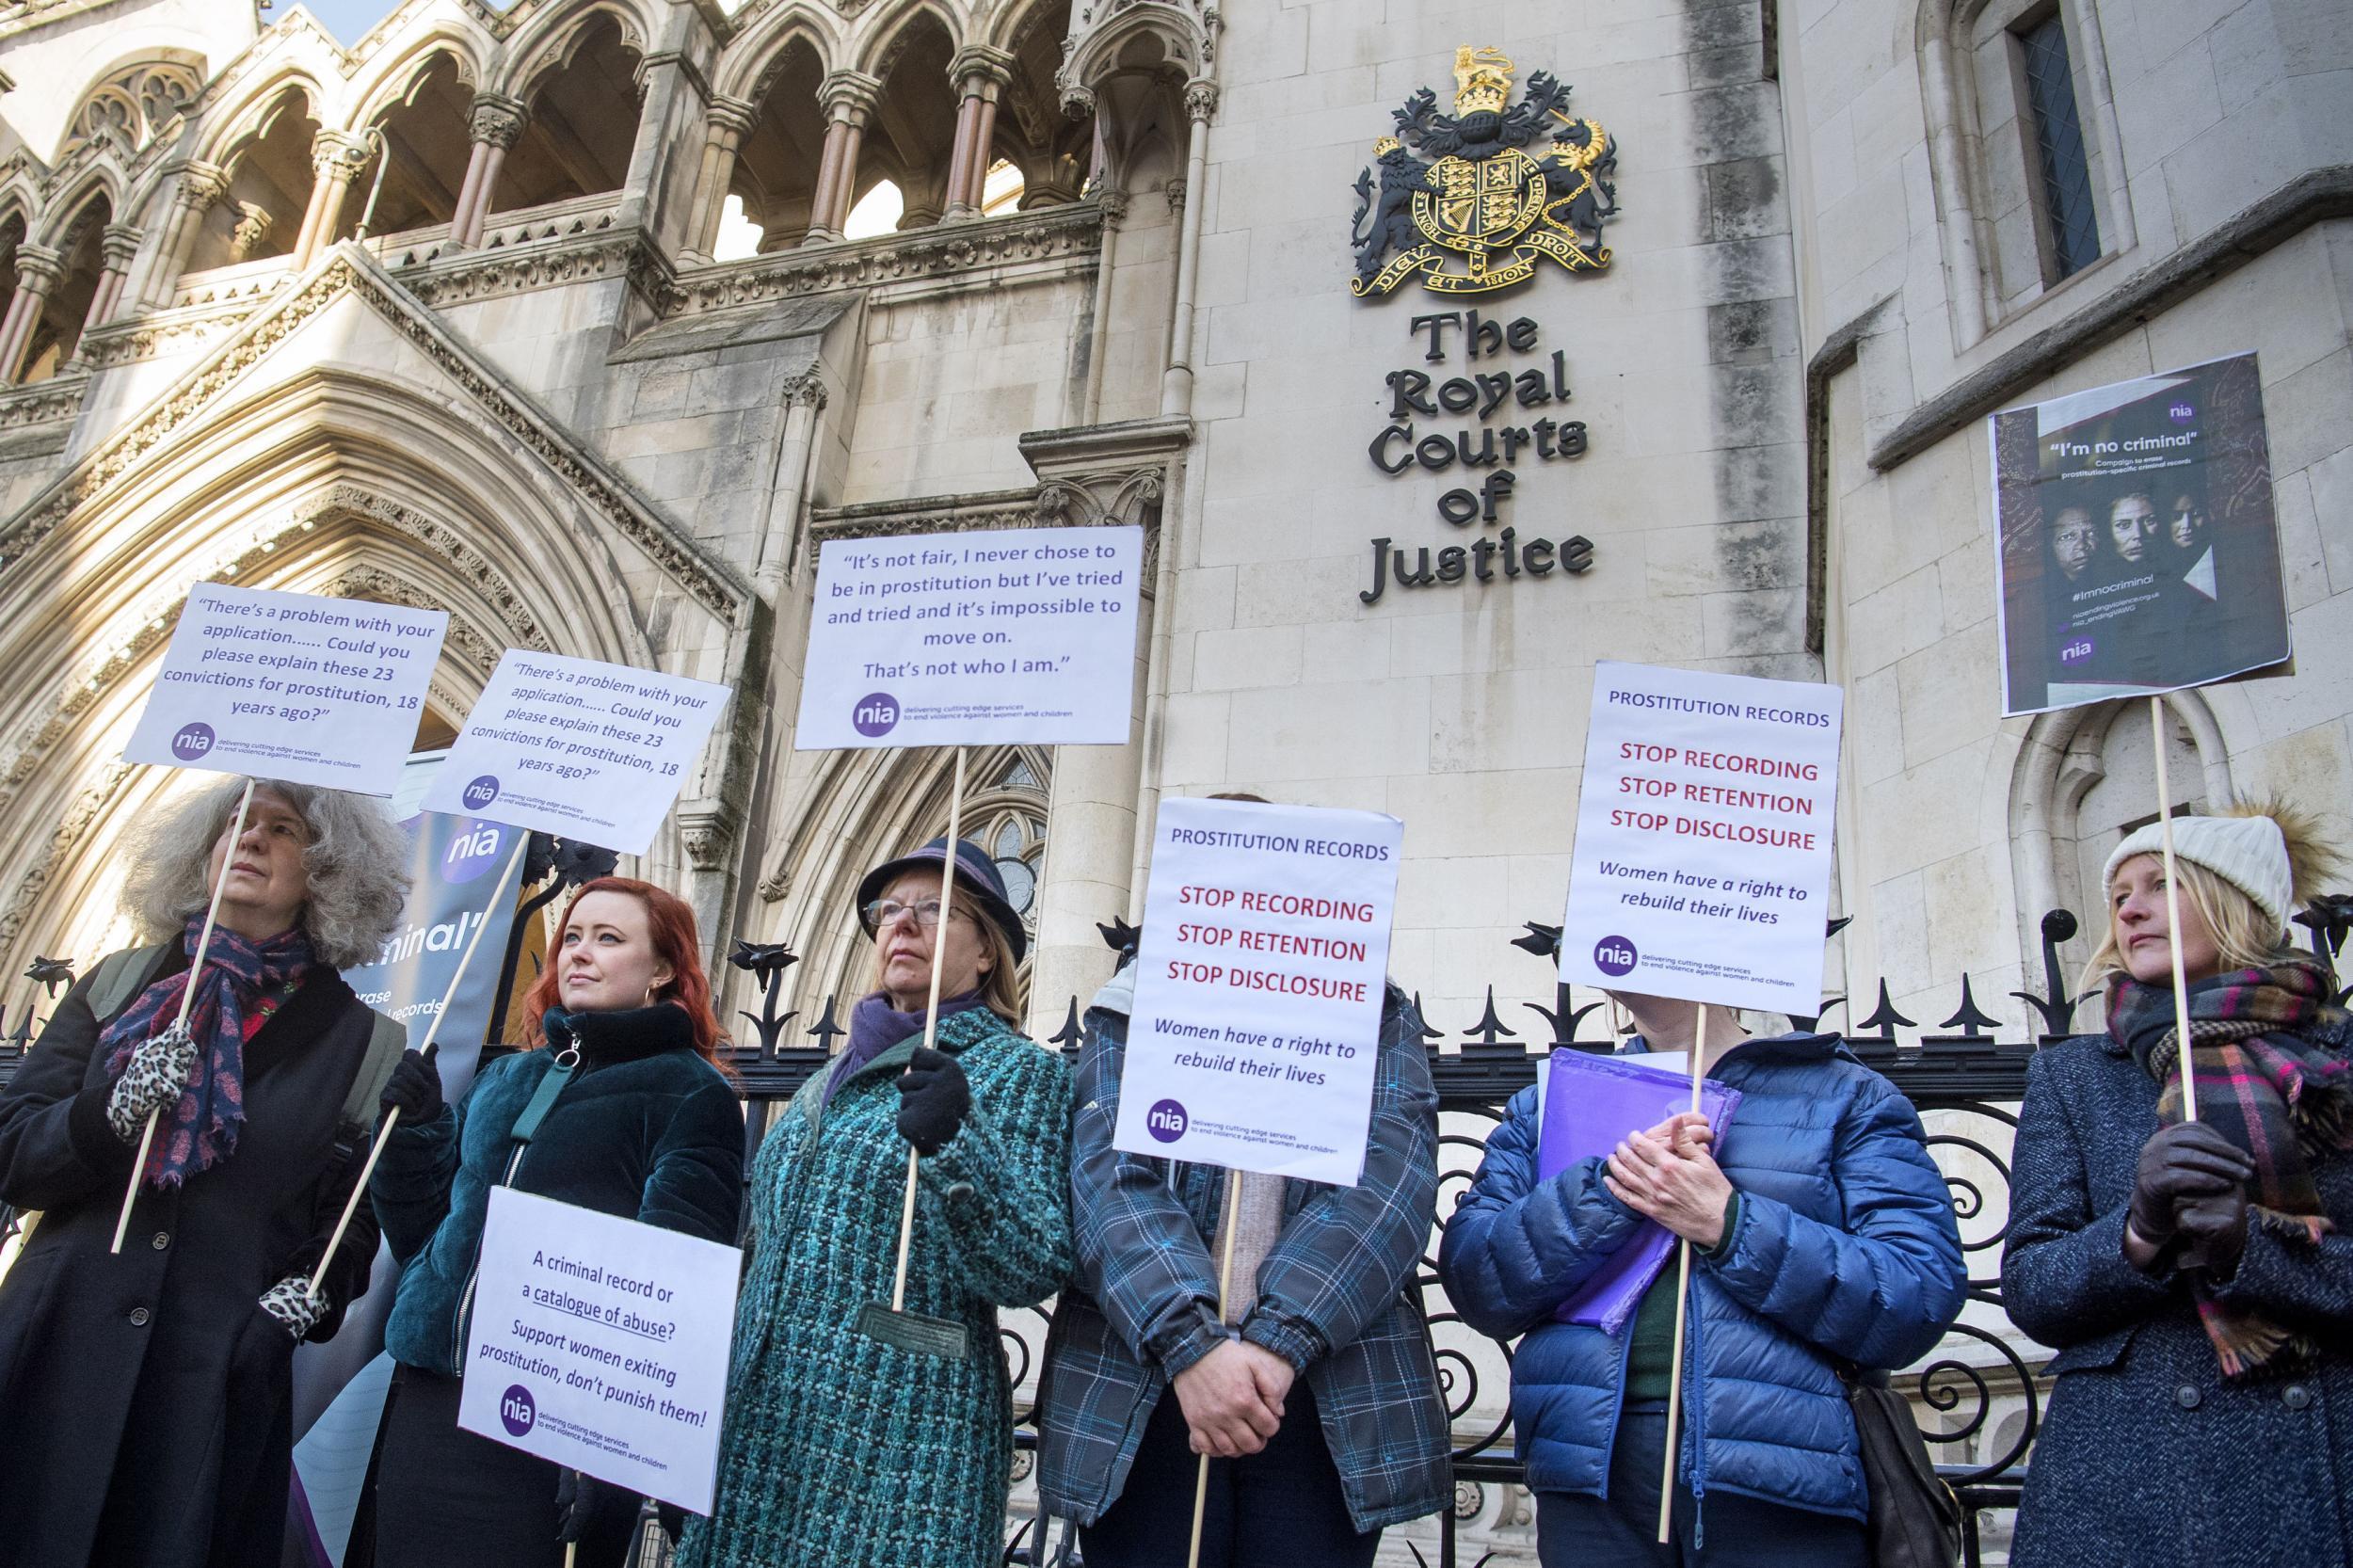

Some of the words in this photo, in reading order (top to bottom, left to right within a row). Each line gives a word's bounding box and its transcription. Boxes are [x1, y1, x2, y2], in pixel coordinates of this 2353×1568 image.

[1525, 232, 1586, 267] DROIT
[1411, 309, 1538, 360] The
[1385, 349, 1571, 419] Royal
[2170, 404, 2193, 418] nia
[1369, 416, 1588, 474] Courts
[2095, 440, 2119, 454] no
[2061, 465, 2137, 480] prostitution-specific
[2138, 461, 2166, 471] criminal
[2167, 457, 2191, 467] records
[2095, 459, 2135, 469] Campaign
[1437, 469, 1516, 524] of
[843, 553, 879, 569] “It’s
[885, 552, 916, 568] not
[920, 549, 956, 566] fair,
[964, 549, 968, 563] I
[975, 549, 1029, 562] never
[1033, 544, 1089, 559] chose
[1095, 545, 1115, 558] to
[1359, 526, 1594, 604] Justice
[831, 582, 853, 597] be
[858, 581, 875, 595] in
[881, 575, 991, 598] prostitution
[998, 572, 1030, 587] but
[1036, 571, 1070, 586] I’ve
[1076, 569, 1122, 585] tried
[2073, 574, 2153, 602] #Imnocriminal
[199, 598, 264, 616] “There’s
[265, 608, 276, 617] a
[279, 609, 349, 627] problem
[355, 617, 392, 632] with
[396, 624, 435, 637] your
[827, 607, 862, 624] and
[867, 604, 910, 621] tried
[916, 601, 951, 619] and
[956, 601, 984, 616] it’s
[990, 598, 1095, 617] impossible
[1100, 600, 1121, 613] to
[327, 636, 376, 654] Could
[378, 646, 410, 659] you
[923, 632, 976, 646] move
[982, 632, 1012, 644] on.
[2062, 642, 2091, 661] nia
[200, 647, 254, 663] please
[258, 654, 317, 671] explain
[323, 660, 369, 678] these
[372, 666, 393, 680] 23
[863, 662, 919, 678] That’s
[925, 661, 957, 675] not
[963, 658, 1005, 674] who
[1012, 658, 1016, 673] I
[1022, 655, 1070, 672] am.”
[163, 670, 255, 688] convictions
[258, 676, 283, 691] for
[285, 682, 391, 708] prostitution,
[396, 695, 419, 709] 18
[514, 662, 565, 680] “There’s
[565, 673, 575, 682] a
[575, 675, 635, 694] problem
[638, 686, 670, 701] with
[672, 694, 708, 709] your
[231, 701, 276, 715] years
[279, 707, 330, 722] ago?”
[610, 702, 653, 721] Could
[652, 713, 681, 728] you
[856, 701, 895, 725] nia
[1609, 690, 1739, 717] PROSTITUTION
[1746, 706, 1829, 728] RECORDS
[175, 728, 211, 752] nia
[504, 707, 547, 723] please
[549, 716, 599, 733] explain
[601, 724, 641, 743] these
[643, 733, 664, 747] 23
[471, 727, 543, 745] convictions
[544, 735, 566, 750] for
[565, 743, 654, 773] prostitution,
[659, 761, 680, 776] 18
[517, 758, 554, 772] years
[555, 764, 600, 780] ago?”
[1620, 742, 1677, 763] STOP
[1684, 749, 1817, 781] RECORDING
[466, 779, 495, 801] nia
[1619, 776, 1677, 797] STOP
[1684, 783, 1812, 815] RETENTION
[447, 823, 501, 863] nia
[1171, 827, 1299, 853] PROSTITUTION
[1304, 839, 1388, 861] RECORDS
[1610, 809, 1668, 831] STOP
[1675, 817, 1815, 850] DISCLOSURE
[1600, 860, 1668, 882] Women
[1673, 870, 1717, 888] have
[1721, 880, 1734, 890] a
[1738, 879, 1784, 898] right
[1788, 886, 1807, 901] to
[1178, 886, 1235, 907] STOP
[1241, 891, 1373, 922] RECORDING
[1621, 891, 1686, 911] rebuild
[1689, 899, 1734, 918] their
[1737, 904, 1779, 924] lives
[1176, 923, 1233, 946] STOP
[1239, 930, 1366, 962] RETENTION
[1597, 944, 1633, 967] nia
[1167, 961, 1223, 984] STOP
[1229, 968, 1367, 1001] DISCLOSURE
[392, 999, 444, 1020] records
[1155, 1017, 1220, 1040] Women
[1224, 1026, 1267, 1047] have
[1272, 1036, 1284, 1048] a
[1288, 1035, 1332, 1056] right
[1337, 1043, 1355, 1058] to
[1174, 1051, 1236, 1072] rebuild
[1240, 1059, 1282, 1078] their
[1285, 1064, 1325, 1085] lives
[1150, 1107, 1184, 1132] nia
[532, 1250, 543, 1267] A
[547, 1256, 602, 1284] criminal
[606, 1273, 653, 1298] record
[657, 1288, 674, 1303] or
[521, 1284, 530, 1297] a
[534, 1288, 601, 1319] catalogue
[604, 1306, 620, 1324] of
[622, 1311, 676, 1341] abuse?
[511, 1319, 567, 1350] Support
[569, 1339, 621, 1368] women
[624, 1358, 677, 1387] exiting
[479, 1343, 561, 1384] prostitution,
[566, 1368, 603, 1395] don’t
[603, 1385, 655, 1412] punish
[659, 1400, 707, 1428] them!
[503, 1396, 532, 1425] nia
[536, 1418, 544, 1428] to
[544, 1422, 556, 1432] end
[556, 1427, 581, 1441] violence
[581, 1434, 602, 1448] against
[602, 1444, 627, 1457] women
[627, 1452, 641, 1461] and
[641, 1456, 667, 1470] children
[537, 1411, 567, 1429] delivering
[567, 1422, 588, 1436] cutting
[588, 1430, 603, 1441] edge
[603, 1435, 629, 1449] services
